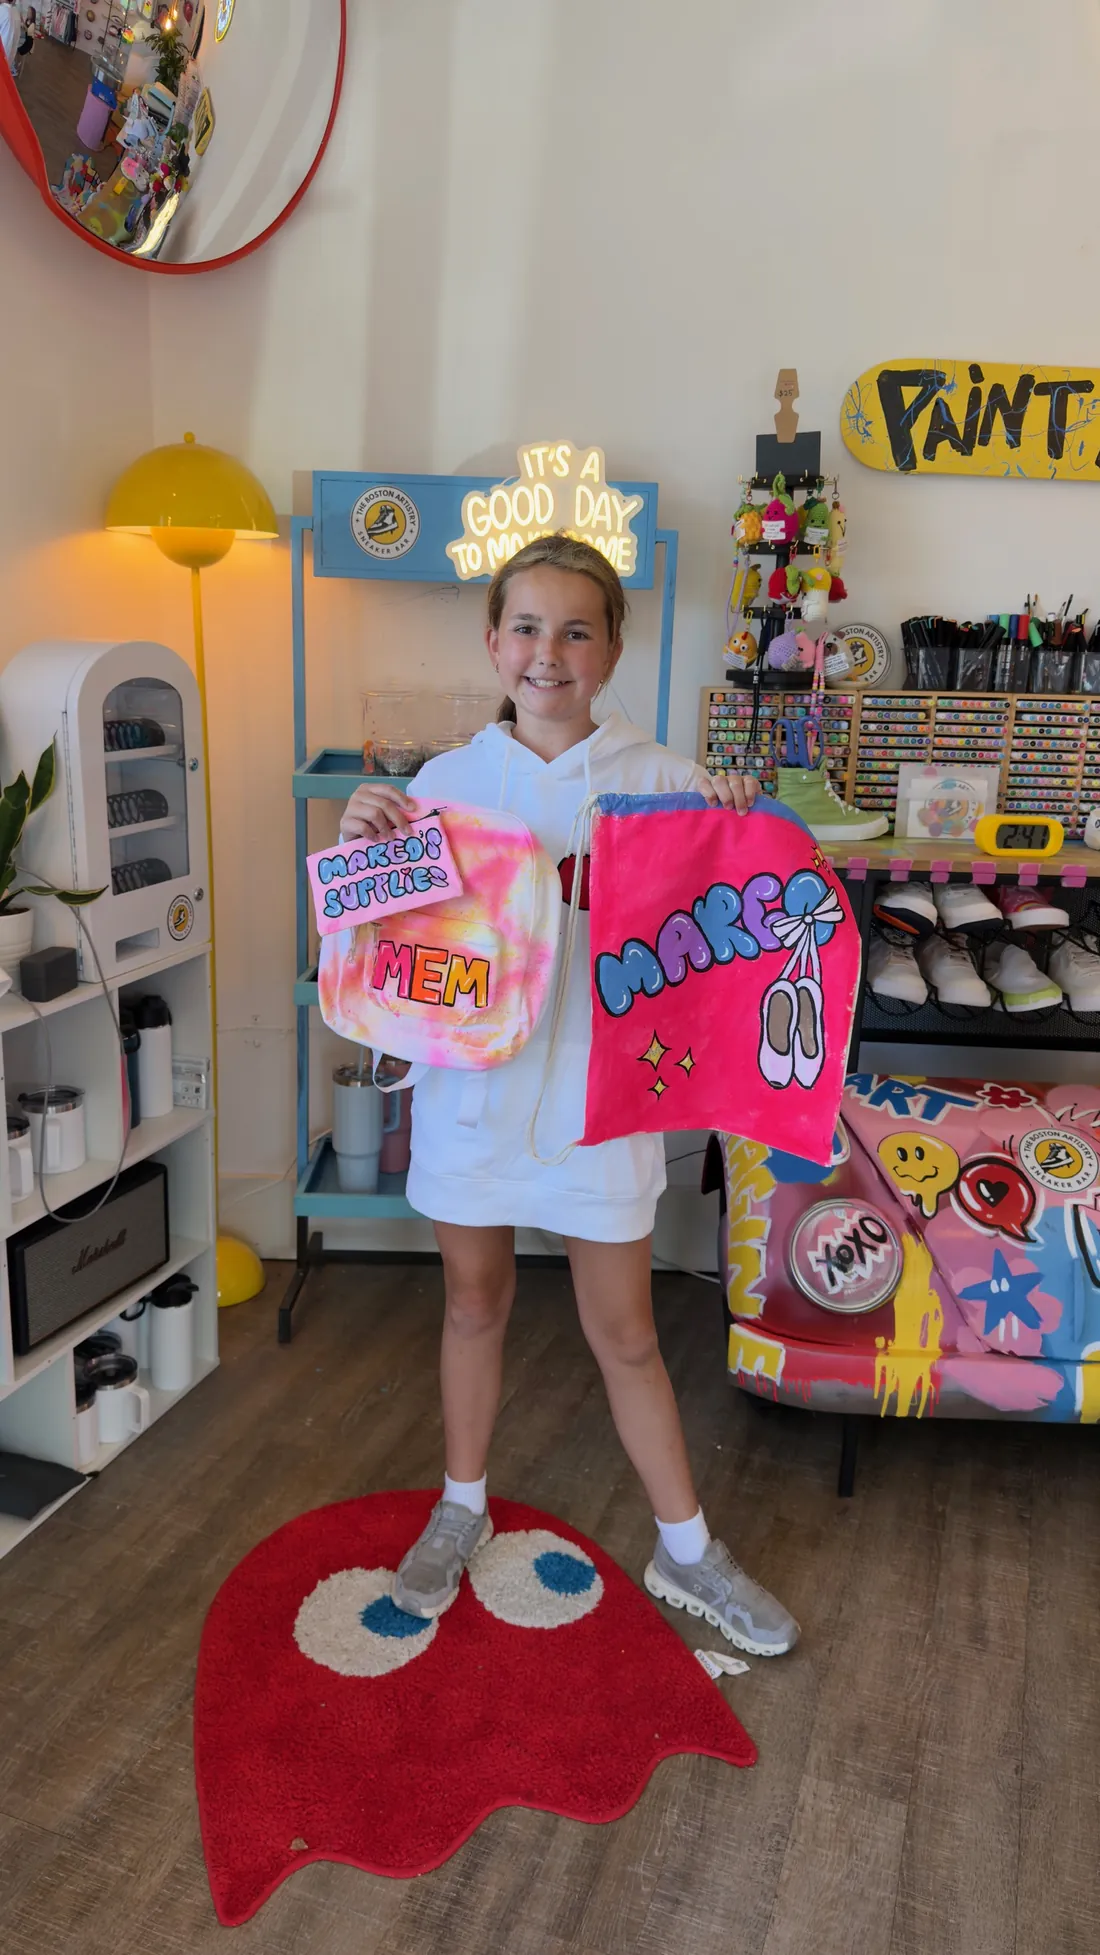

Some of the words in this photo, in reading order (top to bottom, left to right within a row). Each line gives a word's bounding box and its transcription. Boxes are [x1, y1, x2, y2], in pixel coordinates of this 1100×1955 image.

[523, 445, 571, 478] IT'S
[580, 452, 600, 483] A
[356, 501, 367, 515] THE
[364, 489, 394, 503] BOSTON
[395, 494, 416, 526] ARTISTRY
[467, 483, 554, 537] GOOD
[574, 485, 638, 533] DAY
[357, 531, 391, 554] SNEAKER
[395, 538, 410, 551] BAR
[452, 542, 482, 574] TO
[845, 627, 864, 635] STON
[865, 630, 885, 659] ARTISTRY
[864, 670, 878, 681] BAR
[1003, 824, 1048, 848] 2:41
[318, 827, 443, 885] MARGO'S
[595, 868, 838, 1017] MARGO
[372, 940, 490, 1008] MEM
[844, 1072, 983, 1125] ART
[1023, 1139, 1033, 1152] THE
[1029, 1130, 1060, 1142] BOSTON
[1062, 1133, 1094, 1160] ARTISTRY
[1030, 1165, 1073, 1188] SNEAKER
[1076, 1171, 1091, 1185] BAR
